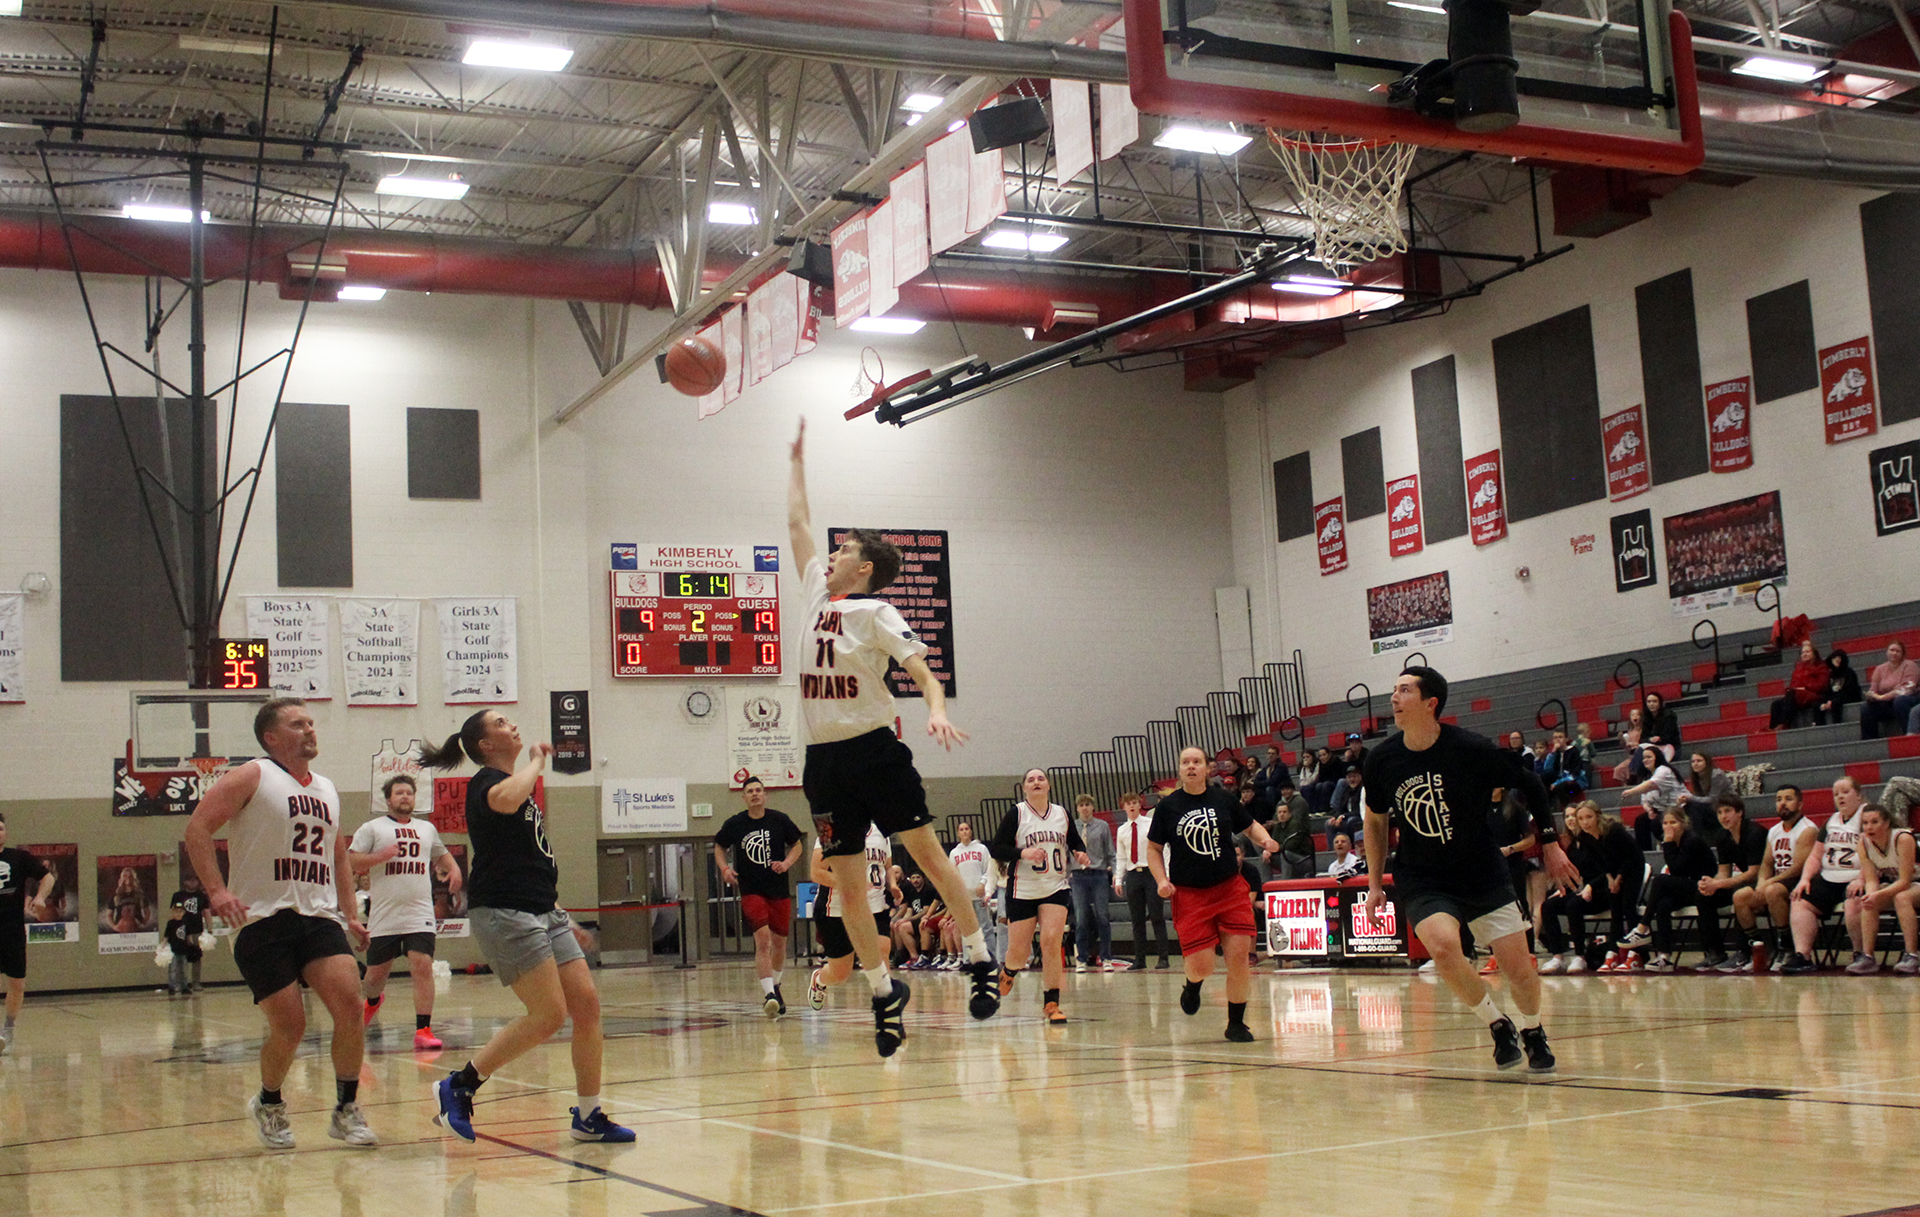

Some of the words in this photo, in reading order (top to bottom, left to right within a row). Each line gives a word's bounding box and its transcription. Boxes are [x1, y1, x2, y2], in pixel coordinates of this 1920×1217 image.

[1822, 347, 1866, 370] KIMBERLY
[1708, 382, 1747, 401] KIMBERLY
[1827, 403, 1872, 426] BULLDOGS
[1604, 411, 1638, 433] KIMBERLY
[1712, 436, 1749, 452] BULLDOGS
[1468, 462, 1497, 480] KIMBERLY
[1609, 461, 1646, 483] BULLDOGS
[1388, 479, 1415, 496] KIMBERLY
[1316, 503, 1341, 520] KIMBERLY
[1472, 509, 1502, 526] BULLDOGS
[1391, 524, 1419, 540] BULLDOGS
[917, 535, 942, 547] SONG
[658, 547, 734, 559] KIMBERLY
[754, 549, 778, 557] PEPSI
[1573, 544, 1593, 555] Fans
[650, 559, 684, 568] HIGH
[686, 560, 742, 569] SCHOOL
[679, 574, 729, 596] 6:14
[263, 601, 292, 615] Boys
[295, 601, 312, 612] 3A
[615, 598, 658, 609] BULLDOGS
[683, 603, 713, 611] PERIOD
[737, 599, 777, 610] GUEST
[371, 607, 387, 618] 3A
[452, 606, 481, 617] Girls
[483, 606, 499, 617] 3A
[662, 612, 682, 620] POSS
[715, 612, 733, 620] POSS
[273, 616, 304, 627] State
[364, 621, 395, 632] State
[462, 620, 491, 631] State
[640, 610, 655, 632] 9
[691, 610, 706, 633] 2
[754, 611, 775, 632] 19
[663, 624, 687, 632] BONUS
[711, 624, 734, 632] BONUS
[276, 631, 303, 643] Golf
[357, 637, 402, 648] Softball
[464, 635, 490, 646] Golf
[618, 634, 644, 642] FOULS
[678, 634, 708, 642] PLAYER
[712, 634, 734, 642] FOUL
[753, 634, 779, 642] FOULS
[225, 642, 265, 660] 6:14
[446, 650, 509, 663] Champions
[626, 642, 641, 666] 0
[761, 642, 775, 665] 0
[816, 637, 836, 669] 11
[347, 651, 412, 665] Champions
[276, 662, 304, 673] 2023
[366, 667, 394, 678] 2024
[465, 665, 491, 676] 2024
[620, 666, 648, 674] SCORE
[694, 666, 722, 674] MATCH
[752, 666, 778, 674] SCORE
[223, 659, 259, 689] 35
[558, 751, 572, 759] 2019
[1395, 774, 1424, 799] BULLDOGS
[632, 792, 643, 803] St
[644, 792, 675, 803] Luke's
[287, 794, 333, 827] BUHL
[1433, 773, 1453, 841] STAFF
[292, 821, 325, 857] 22
[395, 828, 420, 839] BUHL
[1207, 808, 1222, 858] STAFF
[397, 841, 420, 858] 50
[1774, 838, 1792, 851] BUHL
[954, 851, 983, 867] DAWGS
[1774, 853, 1793, 868] 32
[385, 861, 426, 876] INDIANS
[1326, 908, 1340, 918] POSS
[1290, 927, 1322, 951] BULLDOGS
